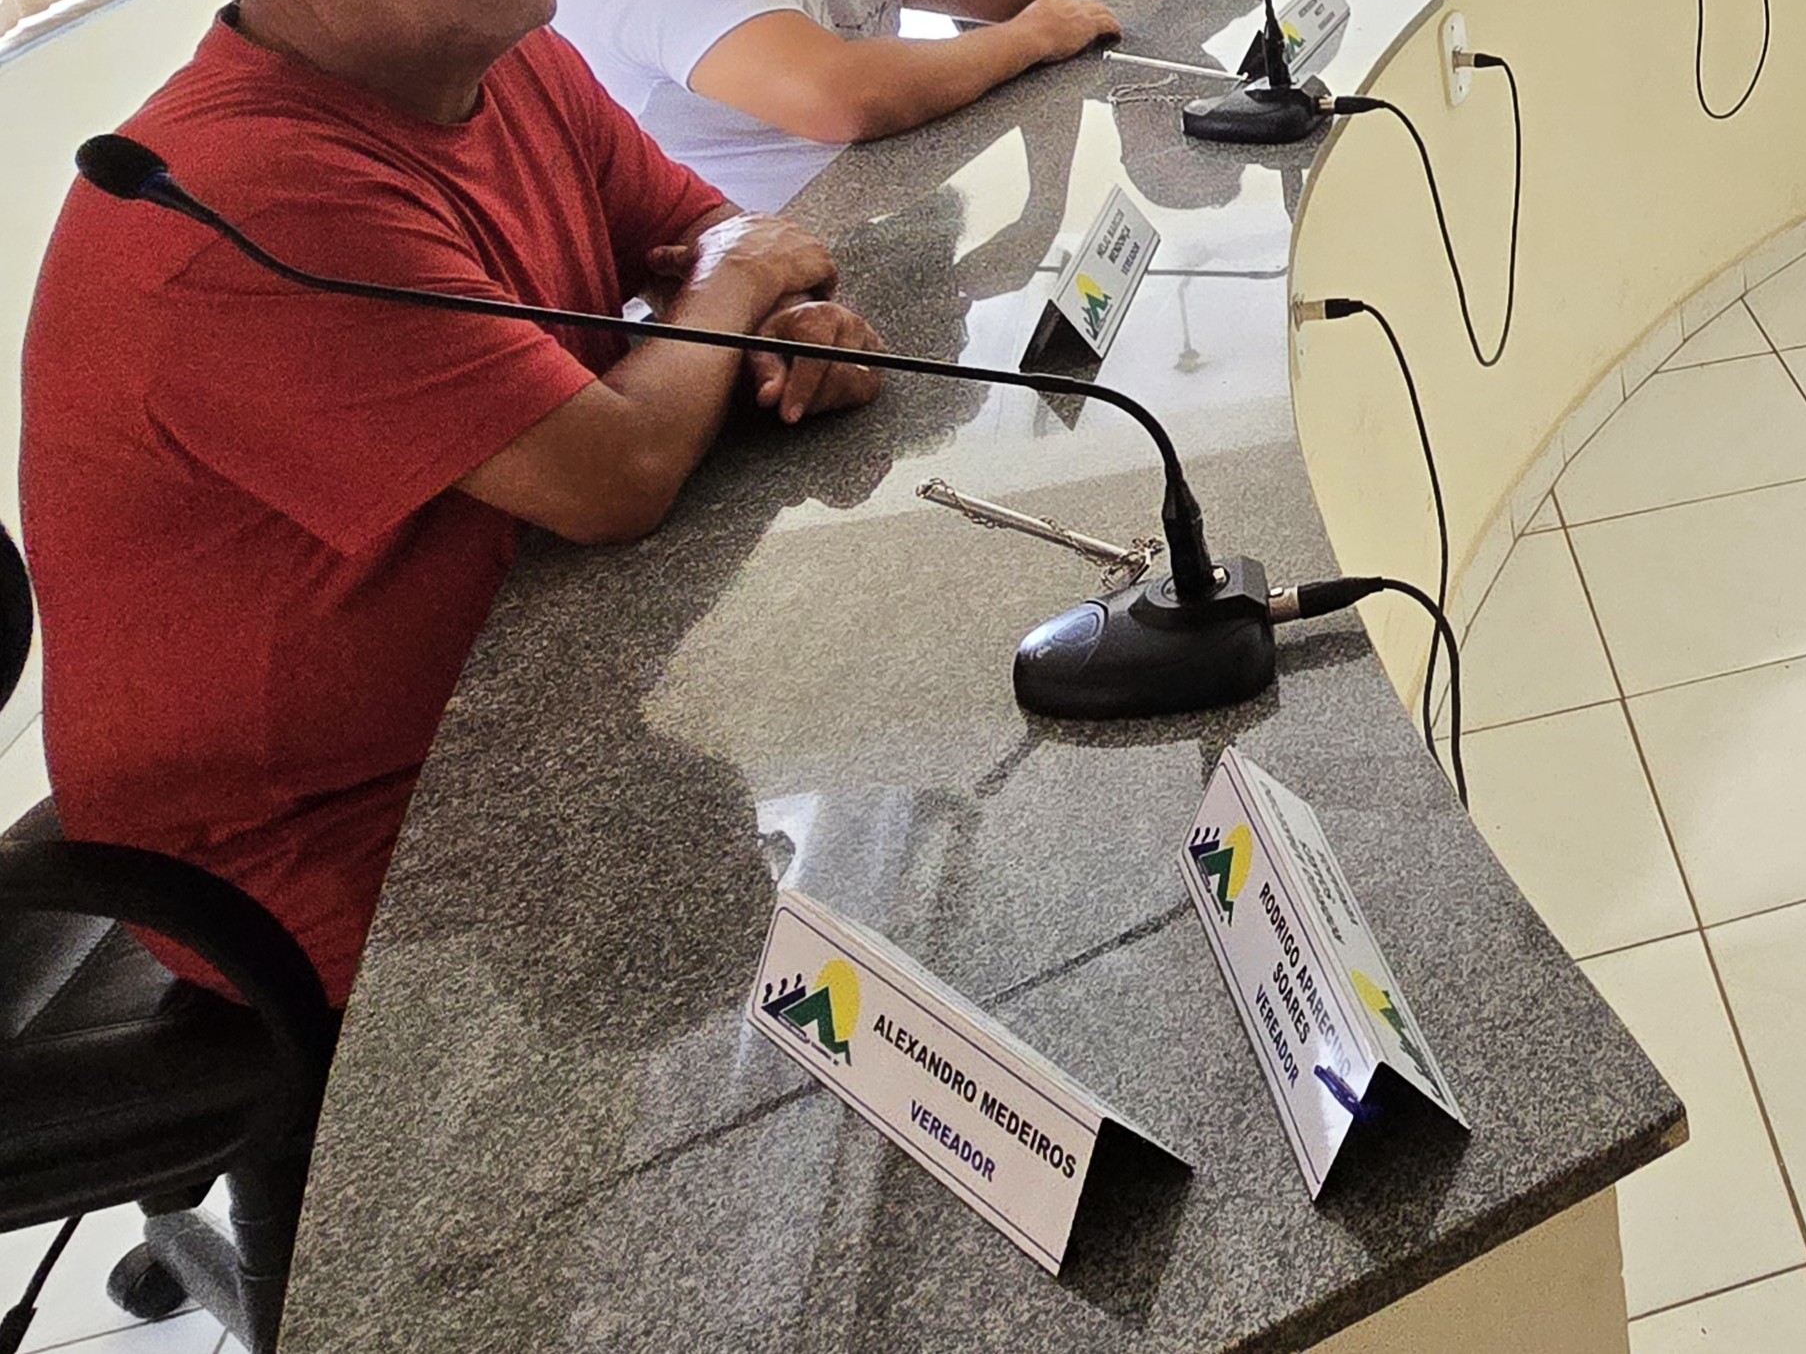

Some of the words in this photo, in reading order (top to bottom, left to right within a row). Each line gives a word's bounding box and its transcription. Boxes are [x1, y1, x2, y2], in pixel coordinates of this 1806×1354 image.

[1258, 881, 1301, 969] RODRIGO
[1255, 983, 1300, 1089] VEREADOR
[1272, 961, 1311, 1045] SOARES
[873, 1014, 977, 1103] ALEXANDRO
[979, 1091, 1077, 1179] MEDEIROS
[910, 1100, 996, 1182] VEREADOR
